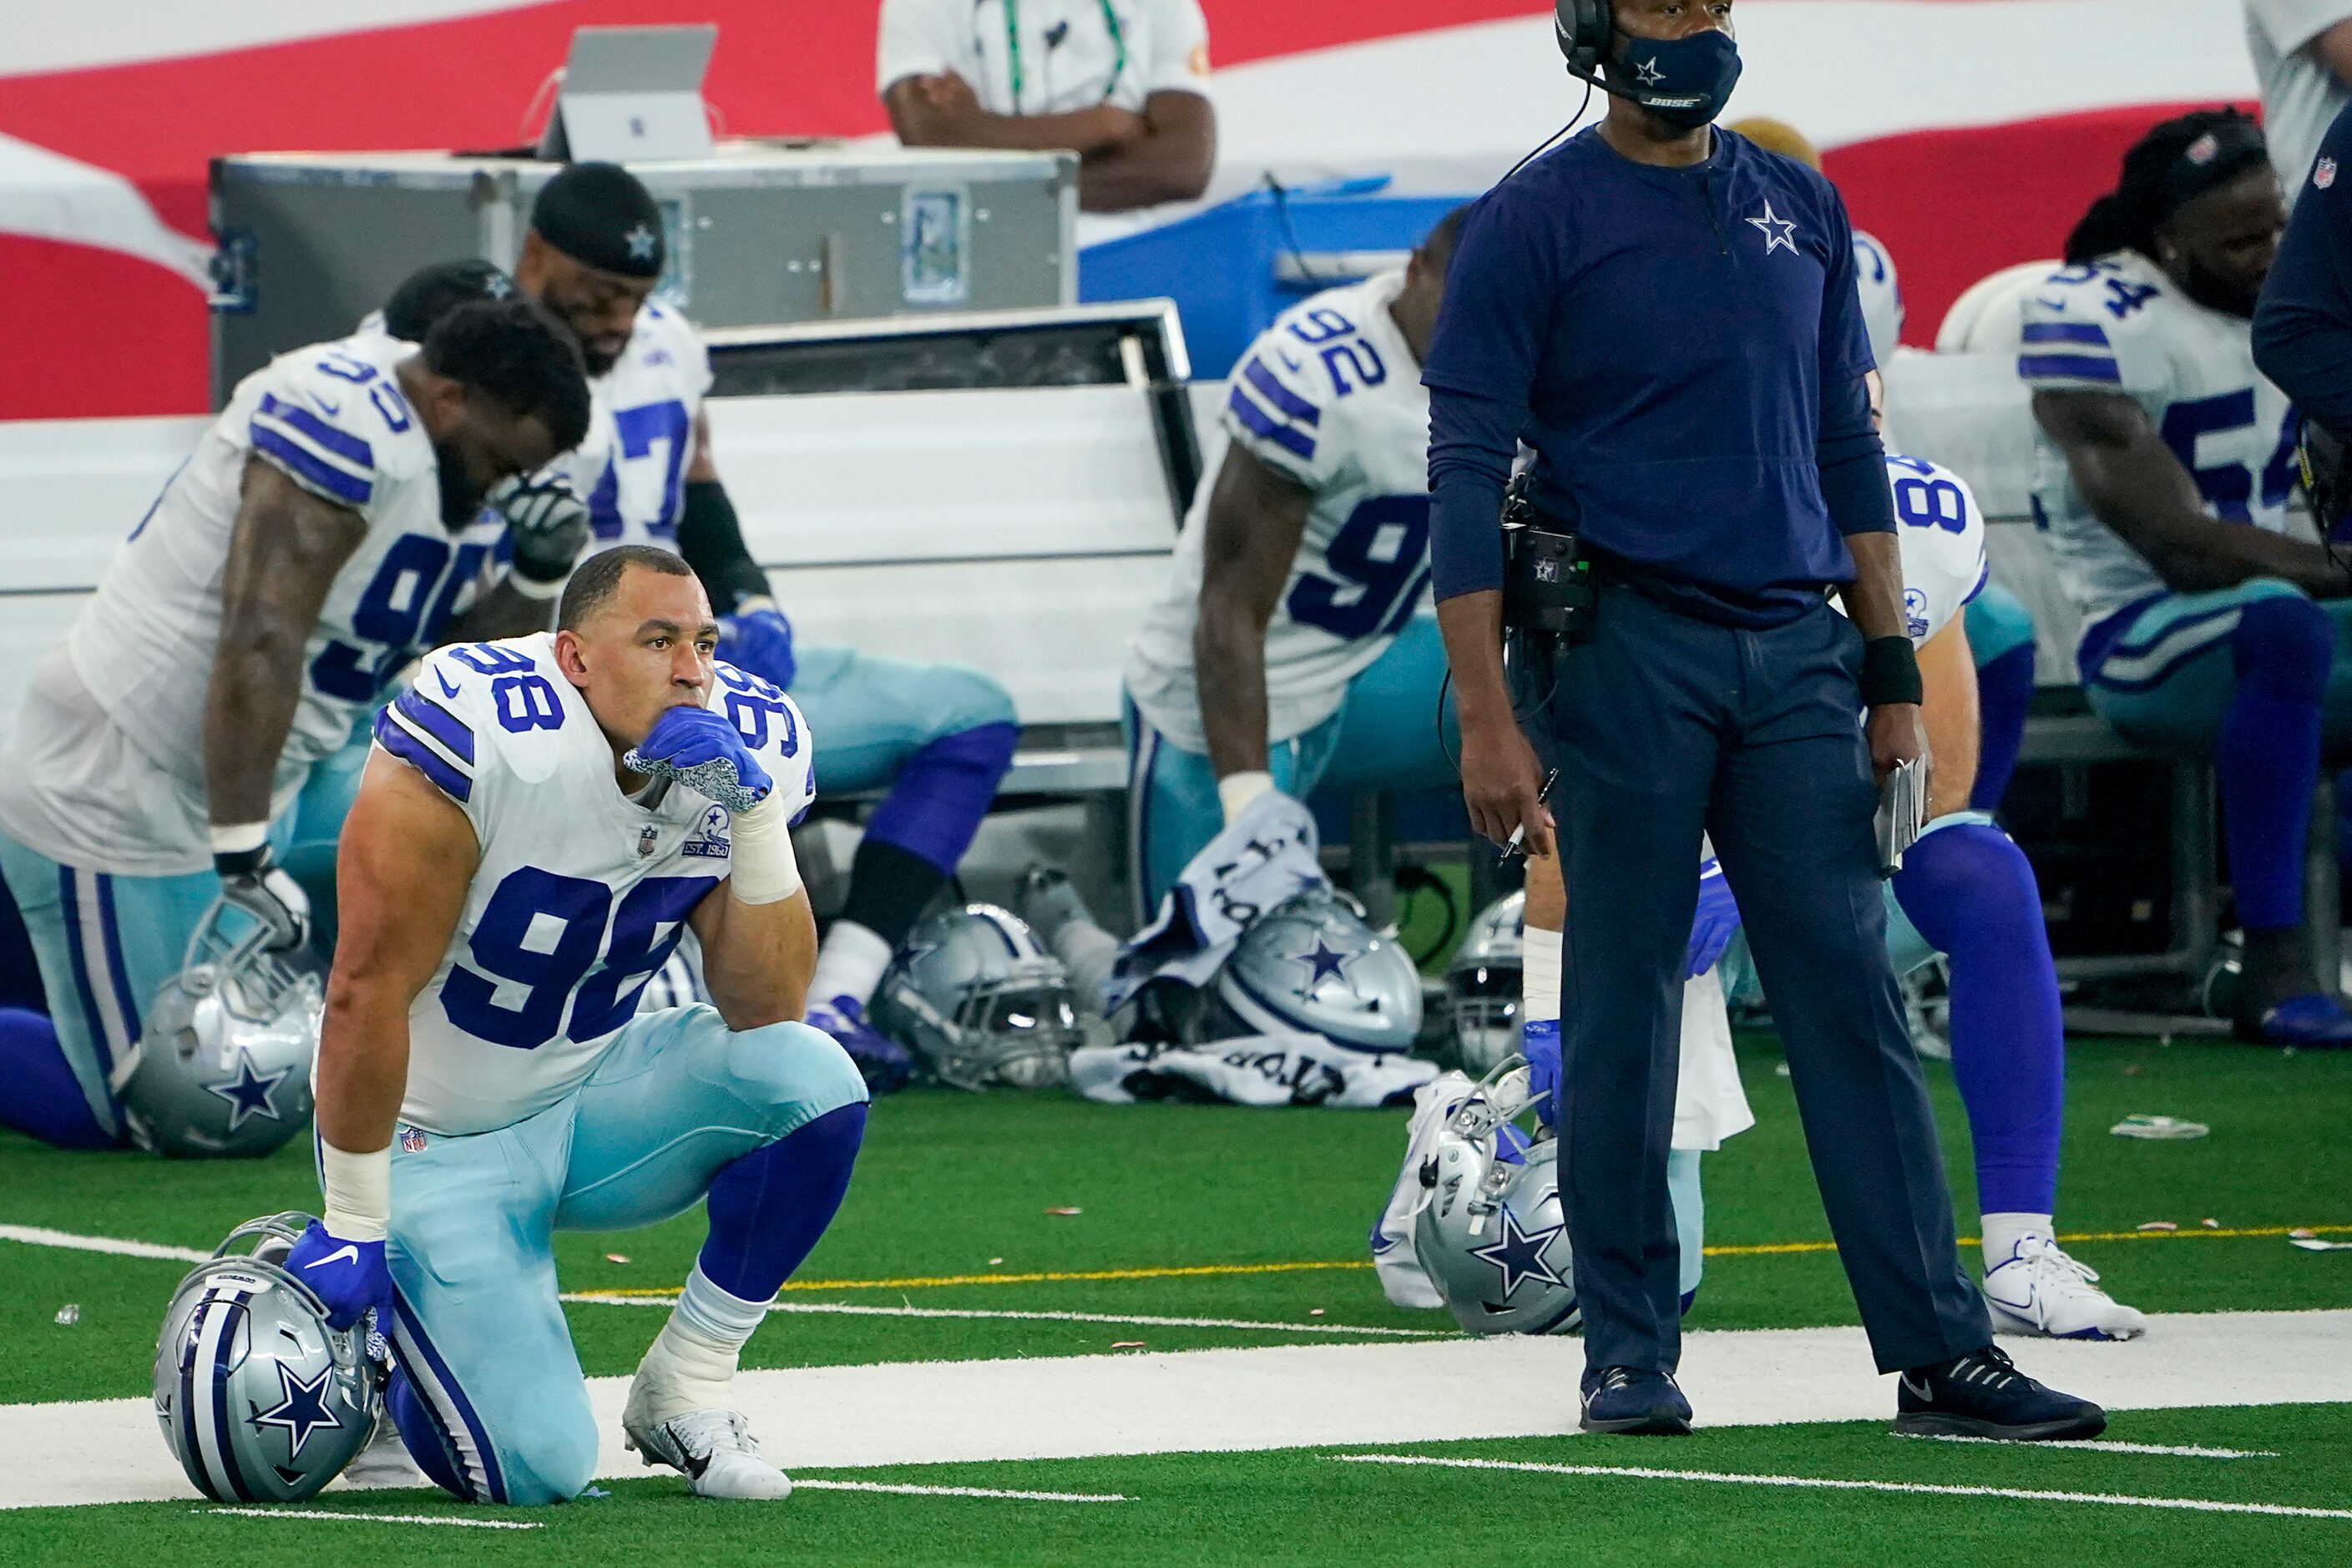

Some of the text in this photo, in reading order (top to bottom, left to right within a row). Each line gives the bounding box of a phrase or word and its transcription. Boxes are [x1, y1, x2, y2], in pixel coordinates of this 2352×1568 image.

[1642, 97, 1701, 108] BOSE
[1288, 309, 1386, 396] 92
[1287, 493, 1431, 641] 9
[448, 642, 565, 733] 98
[714, 665, 798, 759] 98
[438, 866, 721, 1050] 98
[404, 1137, 424, 1151] NFL
